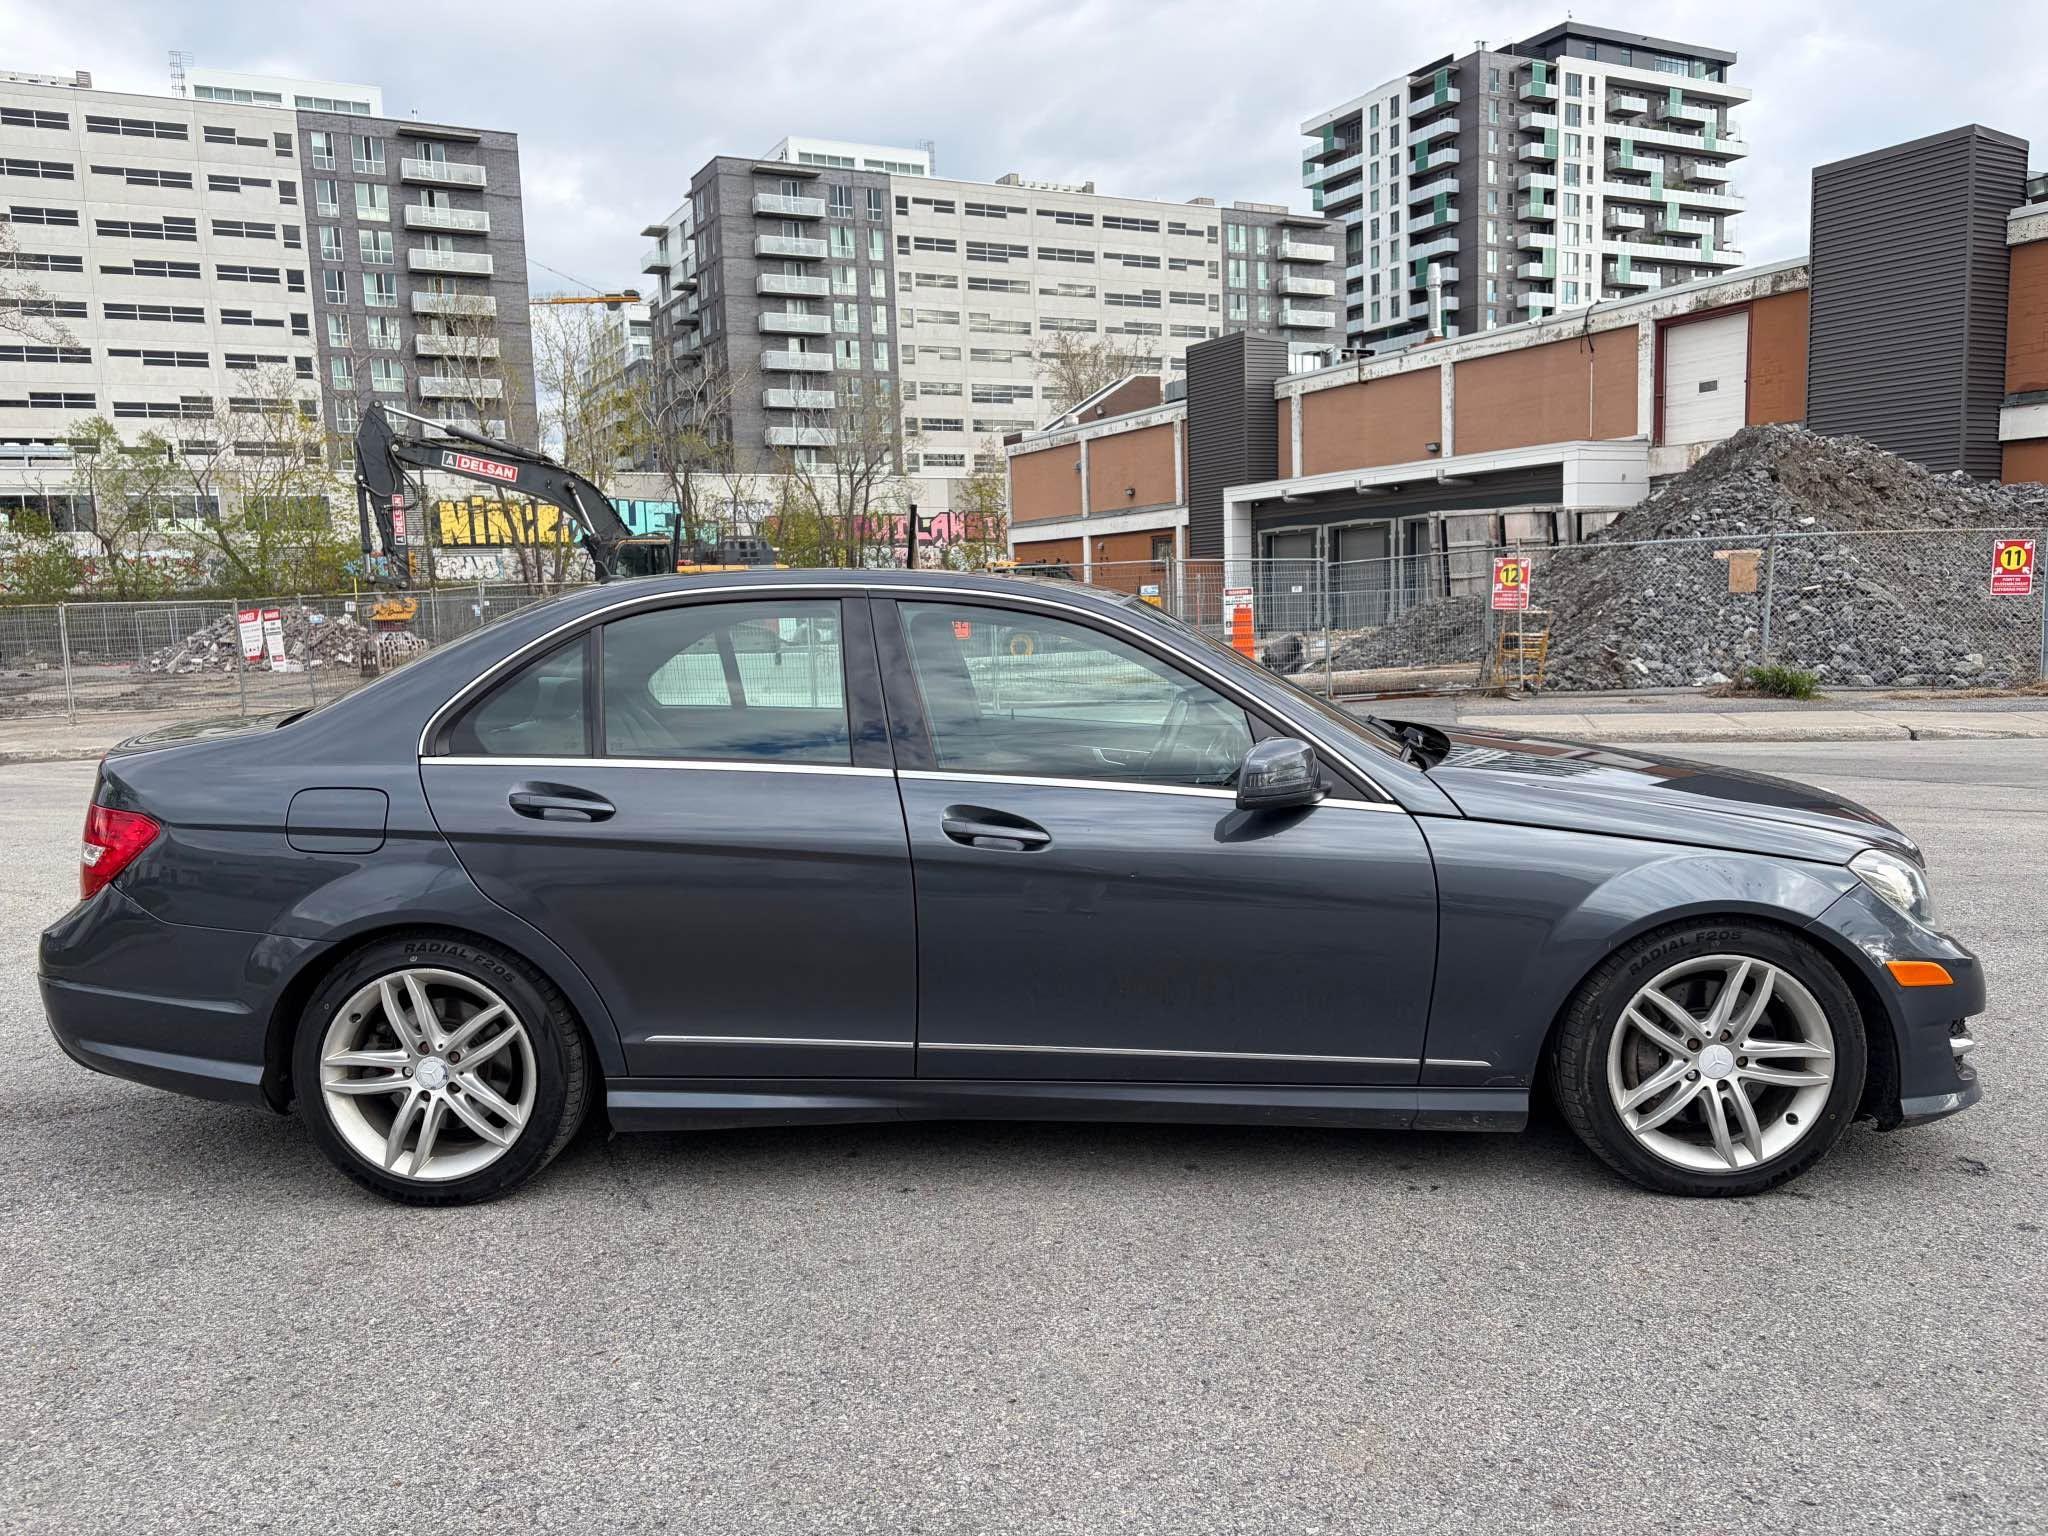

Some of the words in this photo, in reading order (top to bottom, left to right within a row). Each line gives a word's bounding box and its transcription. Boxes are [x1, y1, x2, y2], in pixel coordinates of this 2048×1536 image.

[460, 457, 514, 479] DELSAN
[2004, 549, 2022, 567] 11
[1502, 567, 1519, 583] 12
[403, 942, 469, 959] RADIAL
[473, 953, 516, 983] F205
[1628, 936, 1690, 976] RADIAL
[1695, 930, 1742, 943] F205
